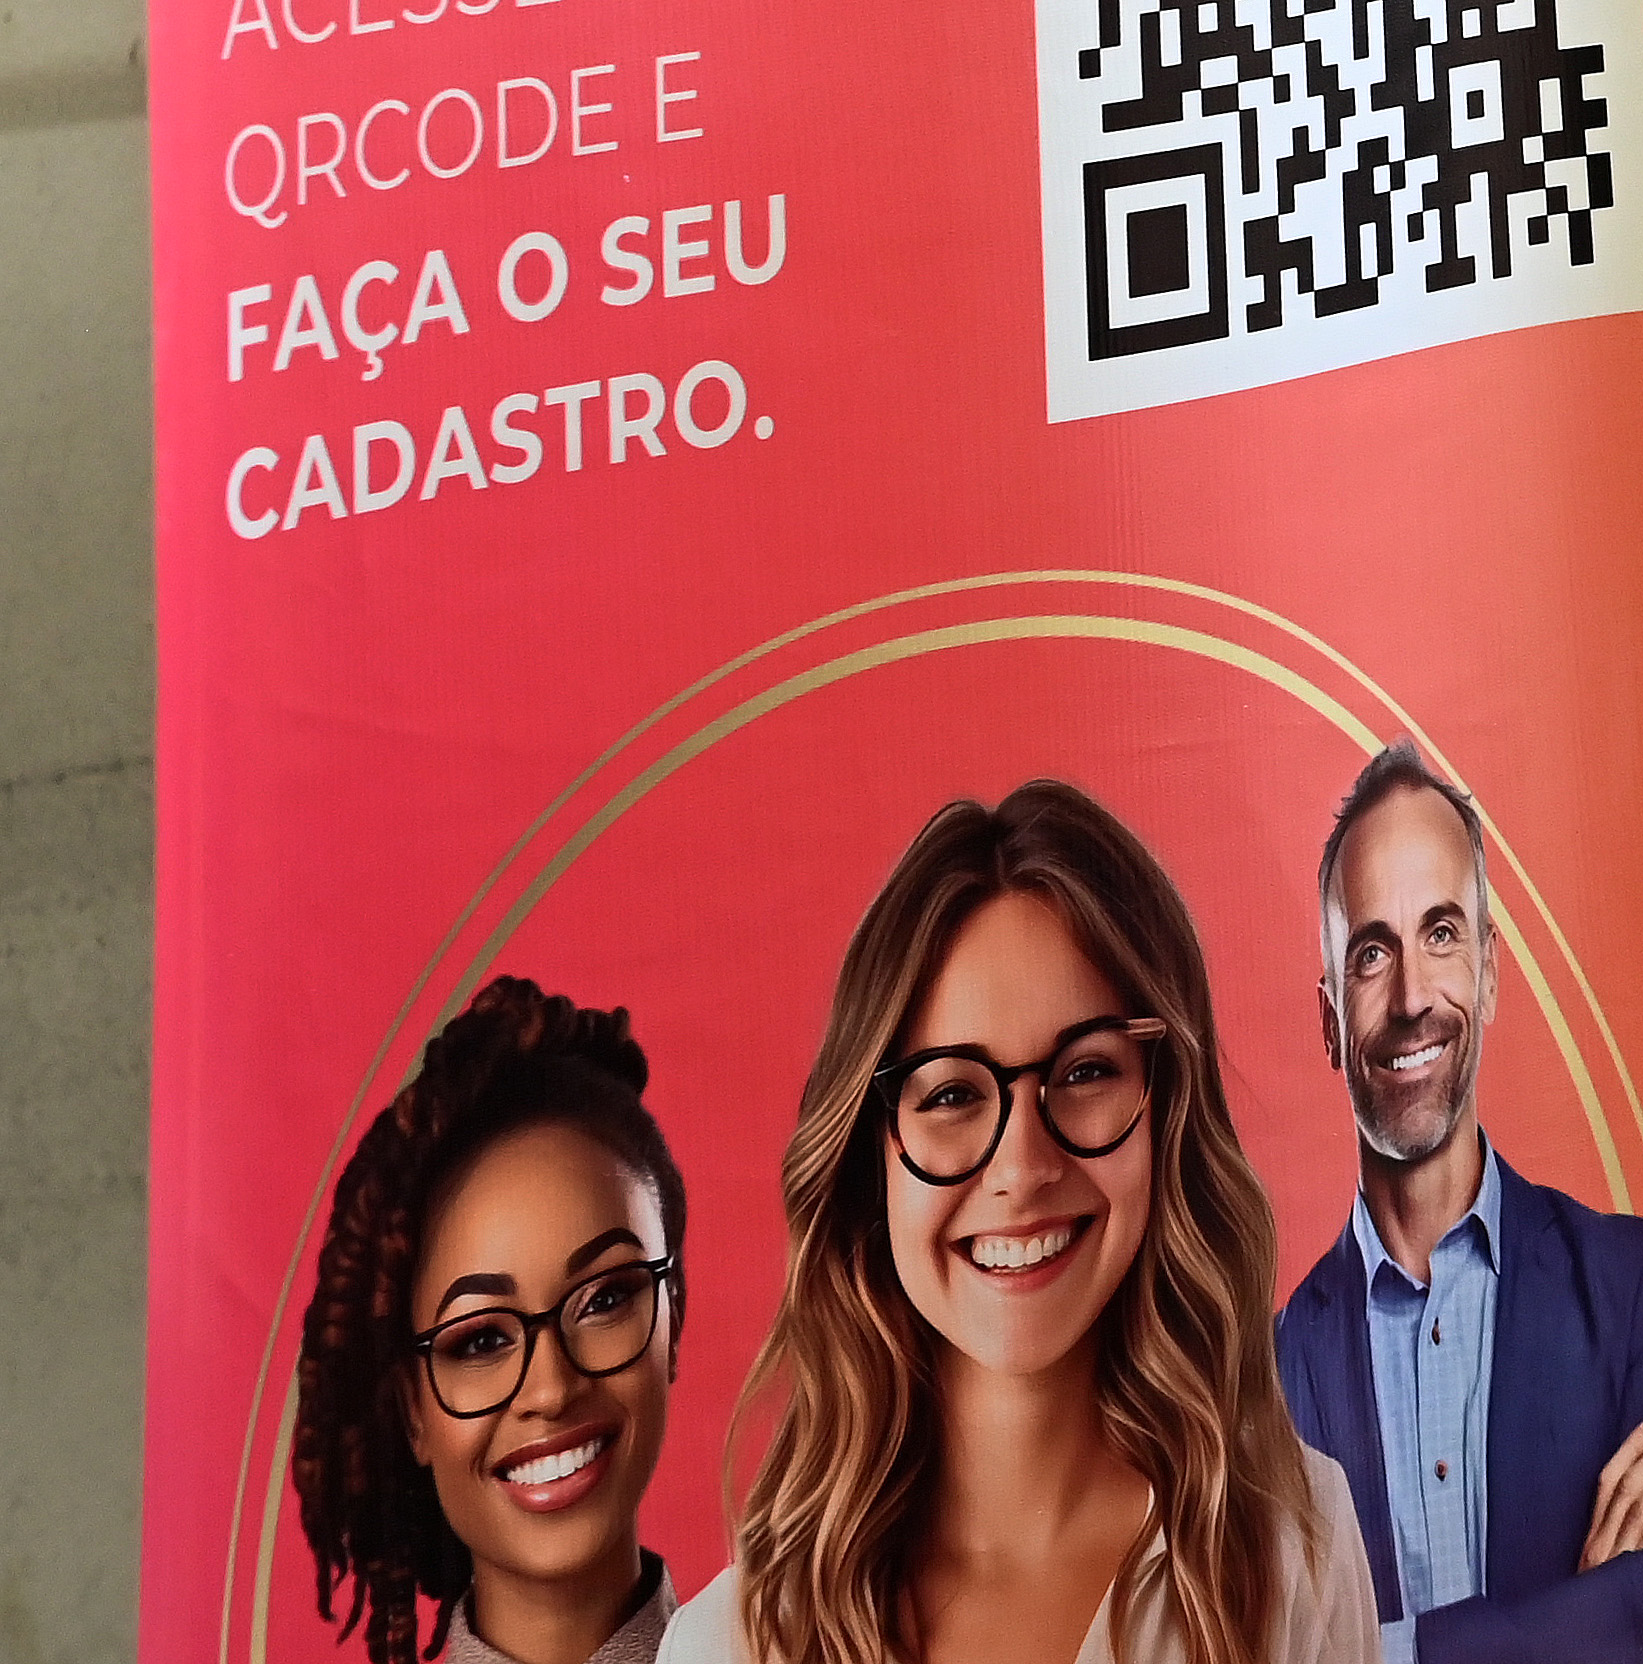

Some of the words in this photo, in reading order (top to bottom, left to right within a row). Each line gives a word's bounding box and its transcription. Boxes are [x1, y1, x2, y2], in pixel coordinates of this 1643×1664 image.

[224, 63, 619, 229] QRCODE
[656, 51, 703, 144] E
[227, 249, 470, 381] FAÇA
[498, 232, 568, 322] O
[600, 194, 787, 307] SEU
[225, 360, 774, 539] CADASTRO.
